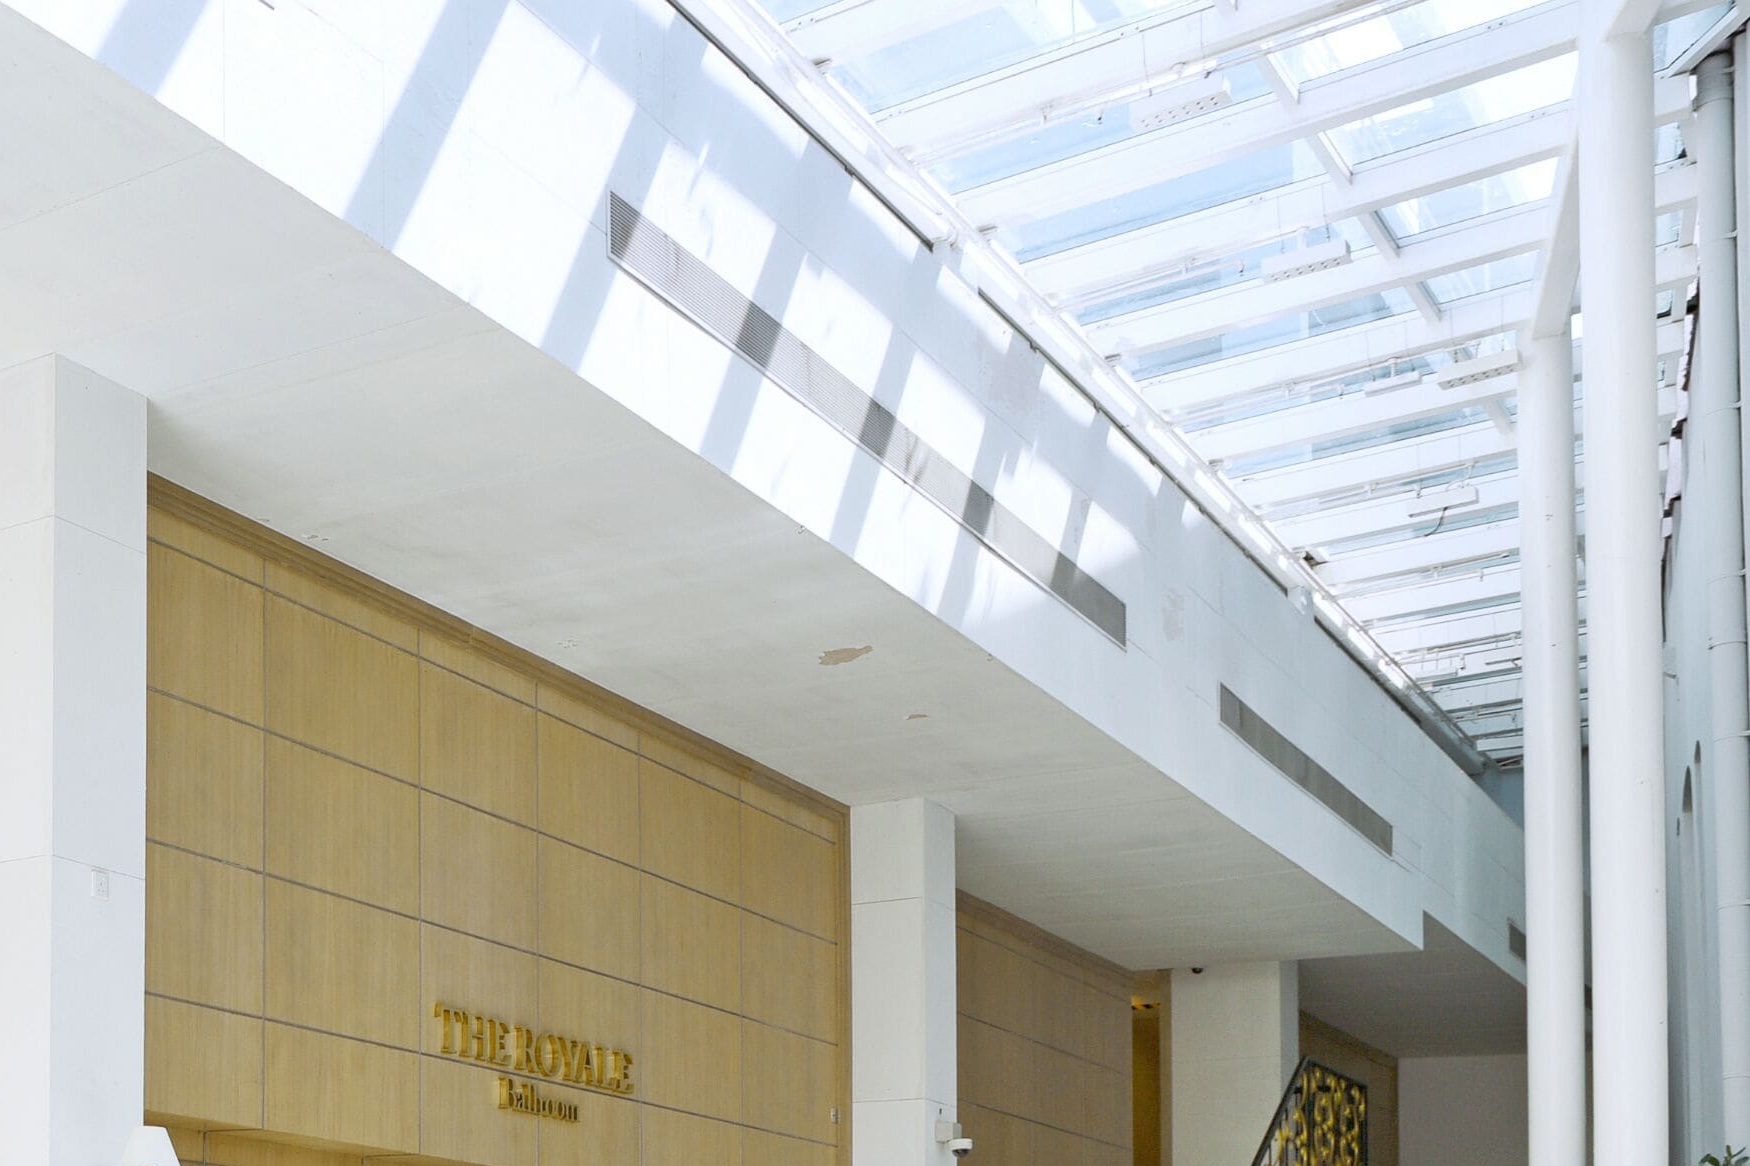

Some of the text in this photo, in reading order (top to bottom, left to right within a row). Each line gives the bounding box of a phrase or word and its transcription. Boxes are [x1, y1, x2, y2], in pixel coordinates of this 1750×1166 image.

[433, 1001, 635, 1095] THE ROYALE
[496, 1076, 580, 1123] Ballroom
